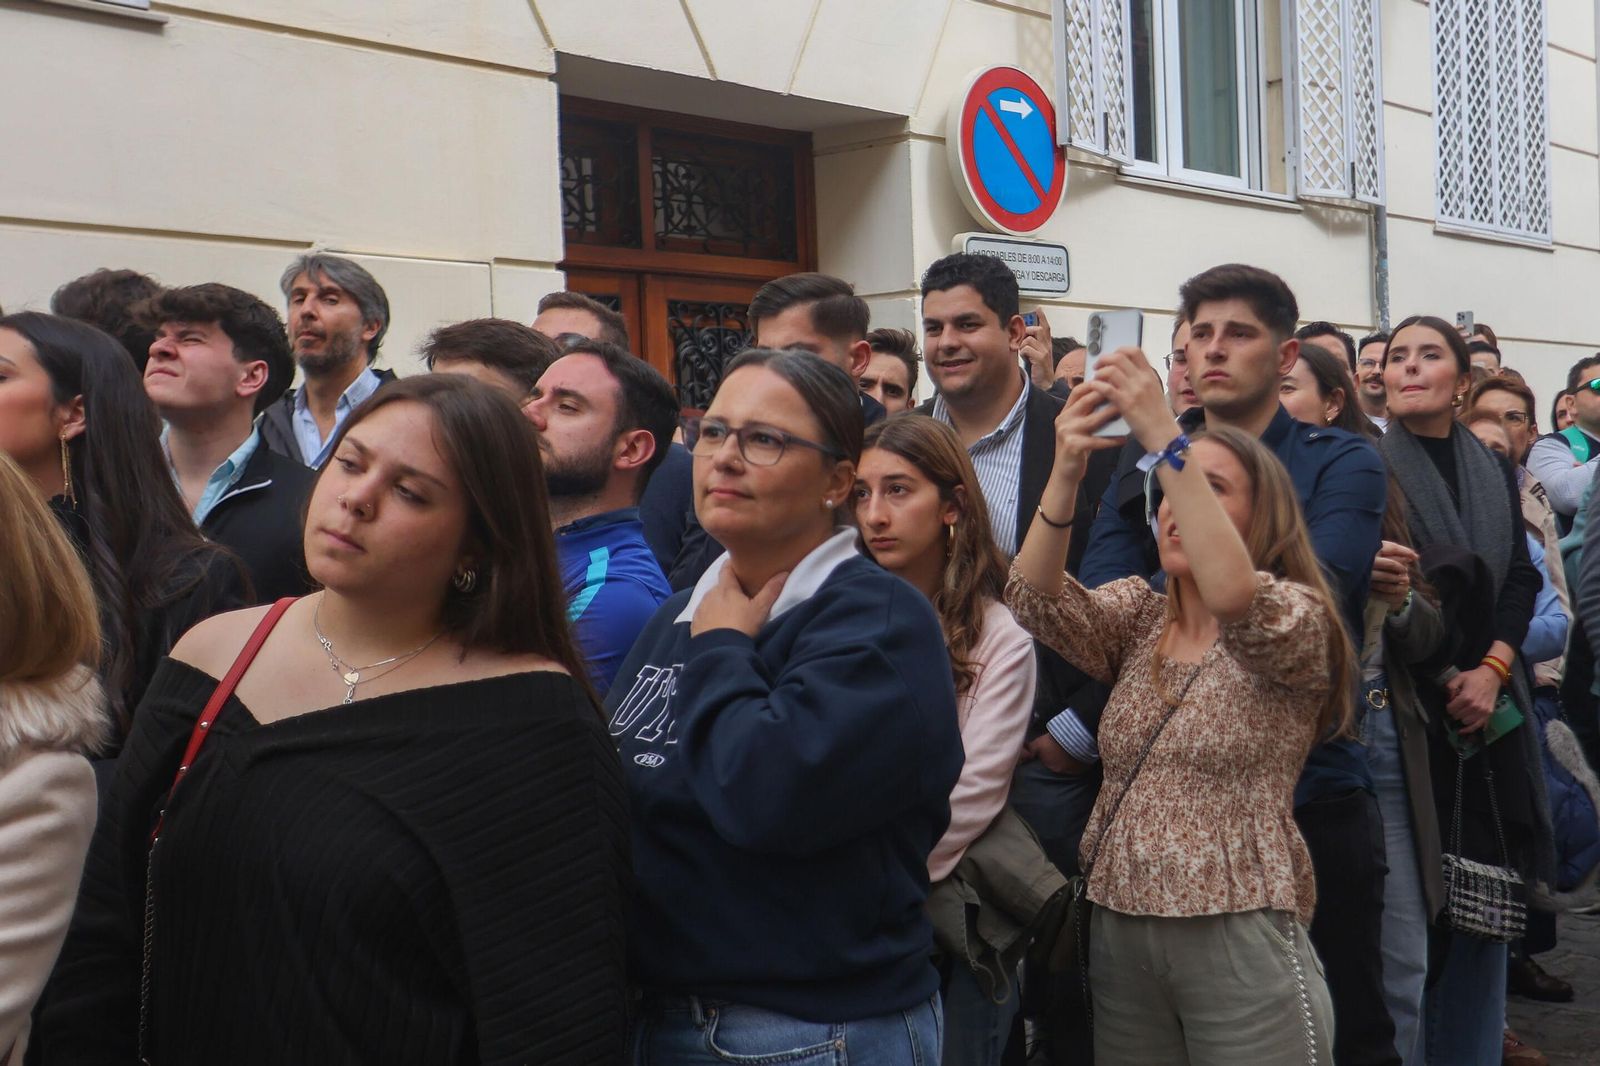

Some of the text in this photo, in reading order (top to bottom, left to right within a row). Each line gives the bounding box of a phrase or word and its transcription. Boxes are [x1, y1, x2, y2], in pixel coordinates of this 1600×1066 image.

[1017, 252, 1027, 263] DE
[1027, 254, 1040, 264] 8:00
[1041, 255, 1046, 264] A
[1025, 270, 1030, 280] Y
[1031, 270, 1066, 282] DESCARGA
[640, 753, 659, 766] USA
